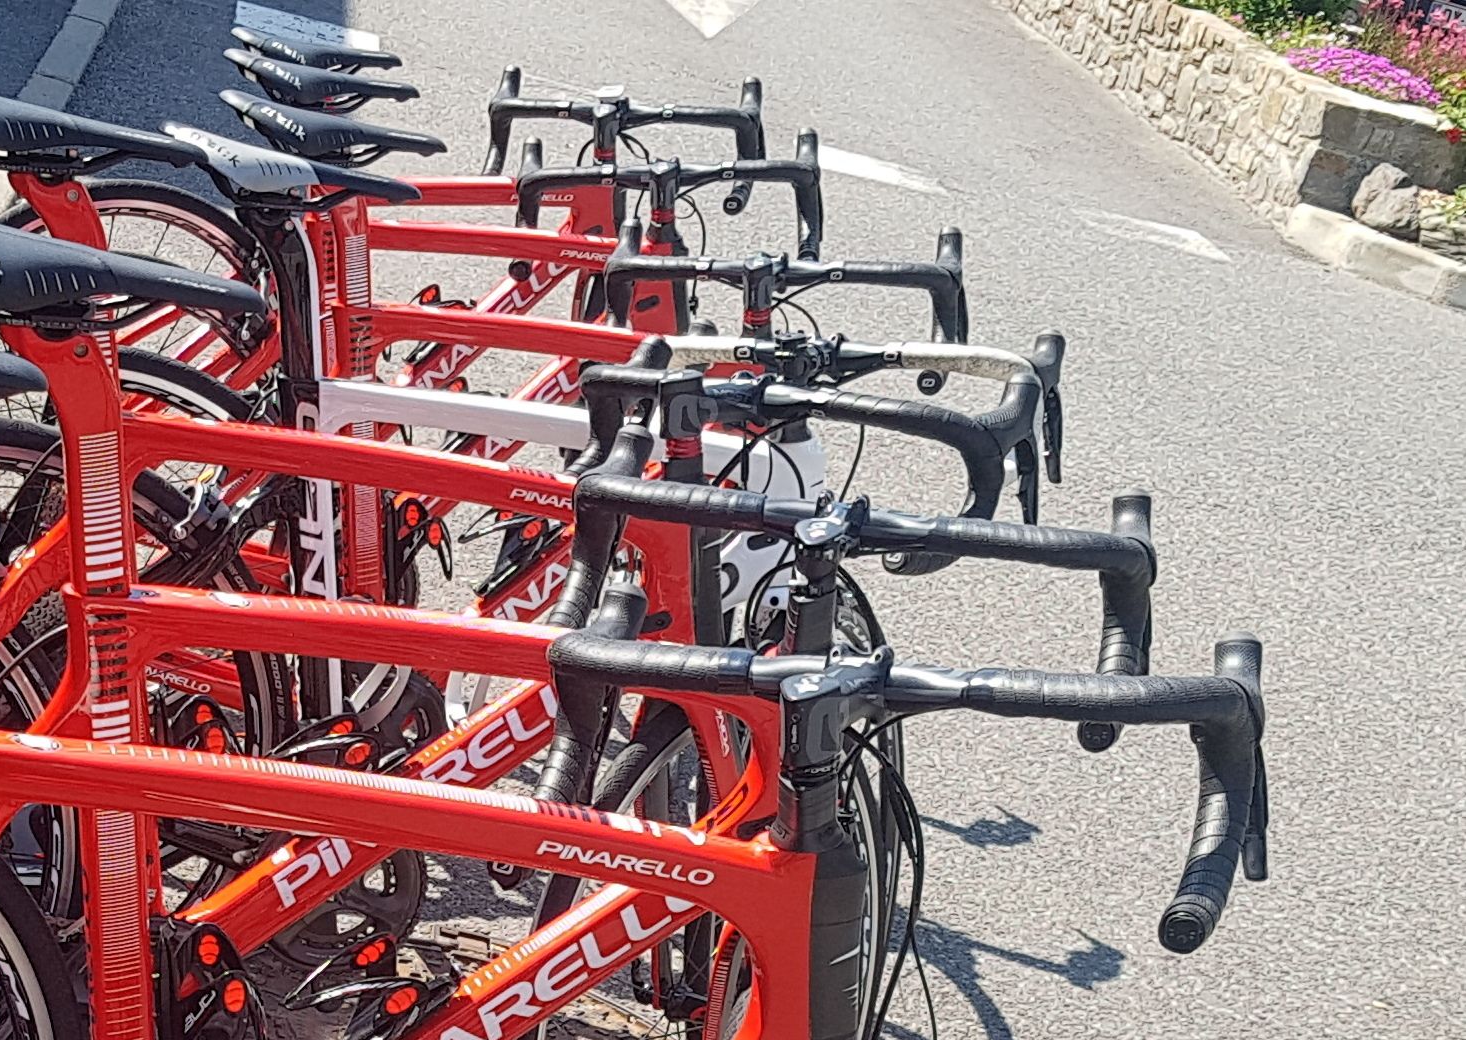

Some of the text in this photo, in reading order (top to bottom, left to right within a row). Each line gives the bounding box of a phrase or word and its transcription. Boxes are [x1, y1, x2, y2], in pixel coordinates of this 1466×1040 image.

[509, 488, 573, 510] PINAR
[145, 666, 211, 693] NARELLO
[536, 839, 715, 887] PINARELLO
